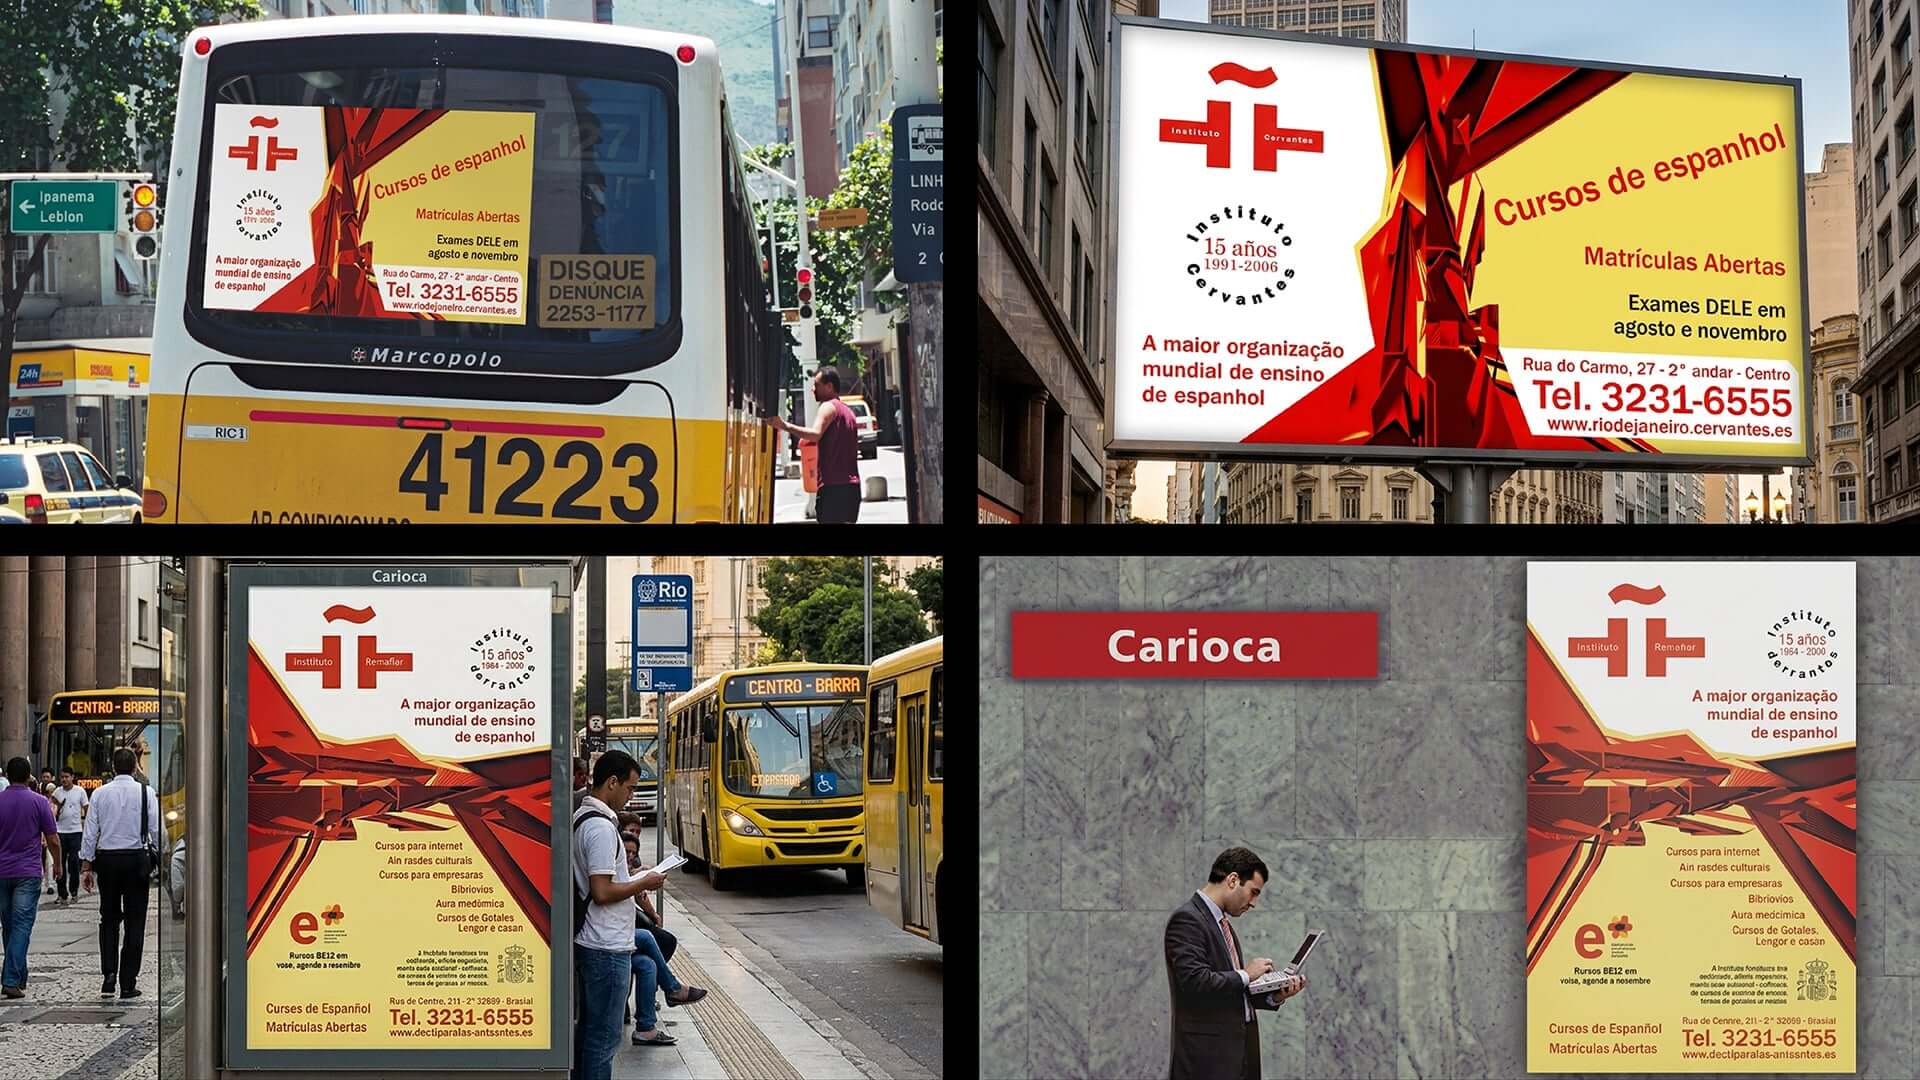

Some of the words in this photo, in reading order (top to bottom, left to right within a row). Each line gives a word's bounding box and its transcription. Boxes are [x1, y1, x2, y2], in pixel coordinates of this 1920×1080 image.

[374, 171, 428, 200] Cursos
[431, 164, 451, 181] de
[454, 134, 526, 172] espanhol
[1494, 180, 1601, 226] Cursos
[1607, 166, 1646, 195] de
[1653, 123, 1787, 180] espanhol
[39, 190, 95, 205] Ipanema
[40, 210, 84, 223] Leblon
[476, 210, 520, 223] Abertas
[911, 222, 935, 236] Via
[1186, 205, 1292, 246] Instituto
[437, 234, 474, 246] Exames
[476, 235, 501, 247] DELE
[503, 238, 519, 248] em
[1204, 237, 1226, 255] 15
[1232, 240, 1277, 258] años
[215, 255, 222, 264] A
[223, 256, 248, 265] maior
[428, 249, 460, 260] agosto
[462, 251, 469, 259] e
[471, 250, 519, 262] novembro
[918, 251, 927, 265] 2
[1584, 246, 1698, 271] Matrículas
[1703, 253, 1786, 277] Abertas
[549, 260, 645, 281] DISQUE
[1204, 258, 1278, 273] 1991-2006
[215, 268, 249, 278] mundial
[250, 270, 262, 279] de
[263, 271, 292, 280] ensino
[383, 269, 398, 278] Rua
[399, 269, 408, 278] do
[438, 272, 448, 281] 27
[493, 274, 519, 283] Centro
[214, 281, 225, 289] de
[226, 282, 266, 292] espanhol
[549, 281, 644, 300] DENÚNCIA
[1187, 263, 1295, 305] Cervantes
[386, 281, 415, 299] Tel.
[420, 283, 518, 304] 3231-6555
[546, 304, 647, 322] 2253-1177
[1628, 294, 1700, 314] Exames
[1705, 298, 1753, 317] DELE
[1757, 303, 1786, 319] em
[1614, 320, 1676, 339] agosto
[1681, 324, 1692, 337] e
[1698, 323, 1787, 342] novembro
[1142, 334, 1157, 351] A
[1163, 337, 1220, 354] maior
[1226, 340, 1345, 362] organização
[370, 347, 501, 368] Marcopolo
[20, 367, 38, 379] 24h
[1143, 362, 1222, 379] mundial
[1229, 364, 1254, 380] de
[1260, 366, 1324, 382] ensino
[1523, 357, 1552, 372] Rua
[1557, 358, 1576, 373] do
[1579, 359, 1633, 376] Carmo,
[1637, 362, 1656, 376] 27
[1691, 365, 1734, 379] andar
[1745, 366, 1791, 381] Centro
[1142, 385, 1167, 403] de
[1174, 388, 1265, 408] espanhol
[1532, 379, 1591, 411] Tel.
[1601, 382, 1793, 418] 3231-6555
[1547, 417, 1793, 438] www.riodejaneiro.cervantes.es
[398, 432, 660, 524] 41223
[372, 569, 427, 583] Carioca
[658, 581, 688, 598] Rio
[1107, 628, 1281, 664] Carioca
[1780, 633, 1794, 646] 15
[481, 648, 495, 661] 15
[1806, 647, 1826, 656] 2000
[749, 678, 802, 695] CENTRO
[815, 676, 860, 693] BARRA
[1692, 689, 1702, 702] A
[1707, 689, 1747, 704] major
[1751, 689, 1838, 705] organização
[69, 700, 114, 715] CENTRO
[400, 698, 410, 710] A
[413, 698, 451, 712] major
[455, 698, 536, 713] organização
[414, 715, 467, 726] mundial
[470, 715, 487, 726] de
[490, 715, 536, 726] ensino
[1707, 708, 1764, 721] mundial
[1768, 708, 1786, 721] de
[1789, 708, 1838, 721] ensino
[455, 731, 471, 743] de
[474, 731, 535, 744] espanhol
[1751, 726, 1768, 739] de
[1772, 726, 1838, 741] espanhol
[375, 840, 405, 851] Cursos
[407, 842, 427, 852] para
[428, 840, 463, 851] internet
[1666, 847, 1698, 857] Cursos
[1700, 848, 1722, 858] para
[1723, 847, 1760, 857] internet
[378, 870, 409, 880] Cursos
[411, 871, 430, 881] para
[1670, 878, 1702, 888] Cursos
[1704, 880, 1726, 889] para
[436, 913, 467, 922] Cursos
[468, 913, 480, 922] de
[289, 911, 319, 945] e
[1732, 925, 1764, 935] Cursos
[1766, 925, 1778, 935] de
[1574, 923, 1605, 959] e
[305, 1003, 319, 1014] de
[389, 1008, 421, 1026] Tel.
[426, 1008, 534, 1026] 3231-6555
[1700, 1016, 1711, 1025] de
[325, 1021, 368, 1033] Abertas
[1591, 1023, 1606, 1034] de
[1681, 1029, 1716, 1047] Tel.
[1722, 1029, 1837, 1047] 3231-6555
[1612, 1042, 1658, 1054] Abertas
